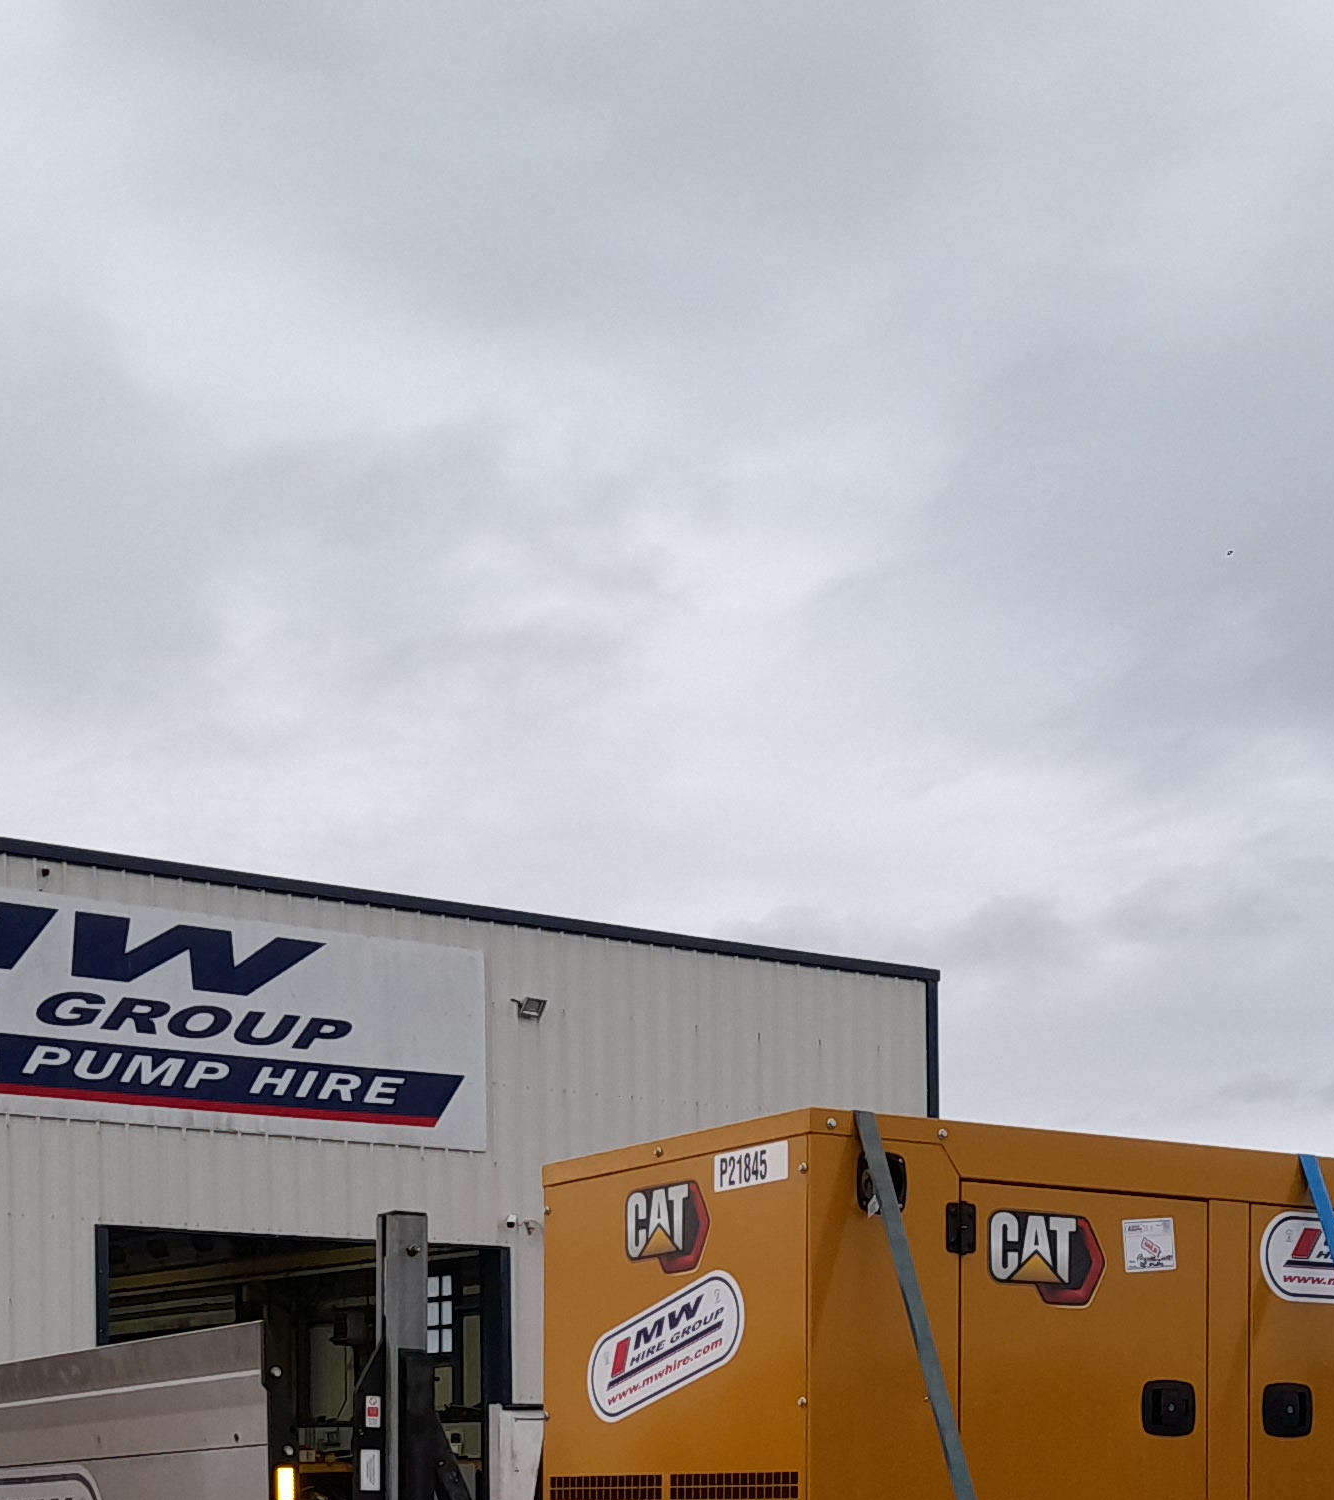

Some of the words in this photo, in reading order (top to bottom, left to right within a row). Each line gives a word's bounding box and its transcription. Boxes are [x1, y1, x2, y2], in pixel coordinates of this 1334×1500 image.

[36, 991, 353, 1050] GROUP
[21, 1044, 230, 1090] PUMP
[248, 1066, 406, 1105] HIRE
[719, 1149, 768, 1188] P21845
[627, 1182, 690, 1259] CAT
[990, 1211, 1077, 1285] CAT
[629, 1338, 666, 1367] HIRE
[669, 1306, 725, 1345] GROUP
[633, 1293, 705, 1351] MW
[607, 1337, 724, 1406] www.mwhire.com
